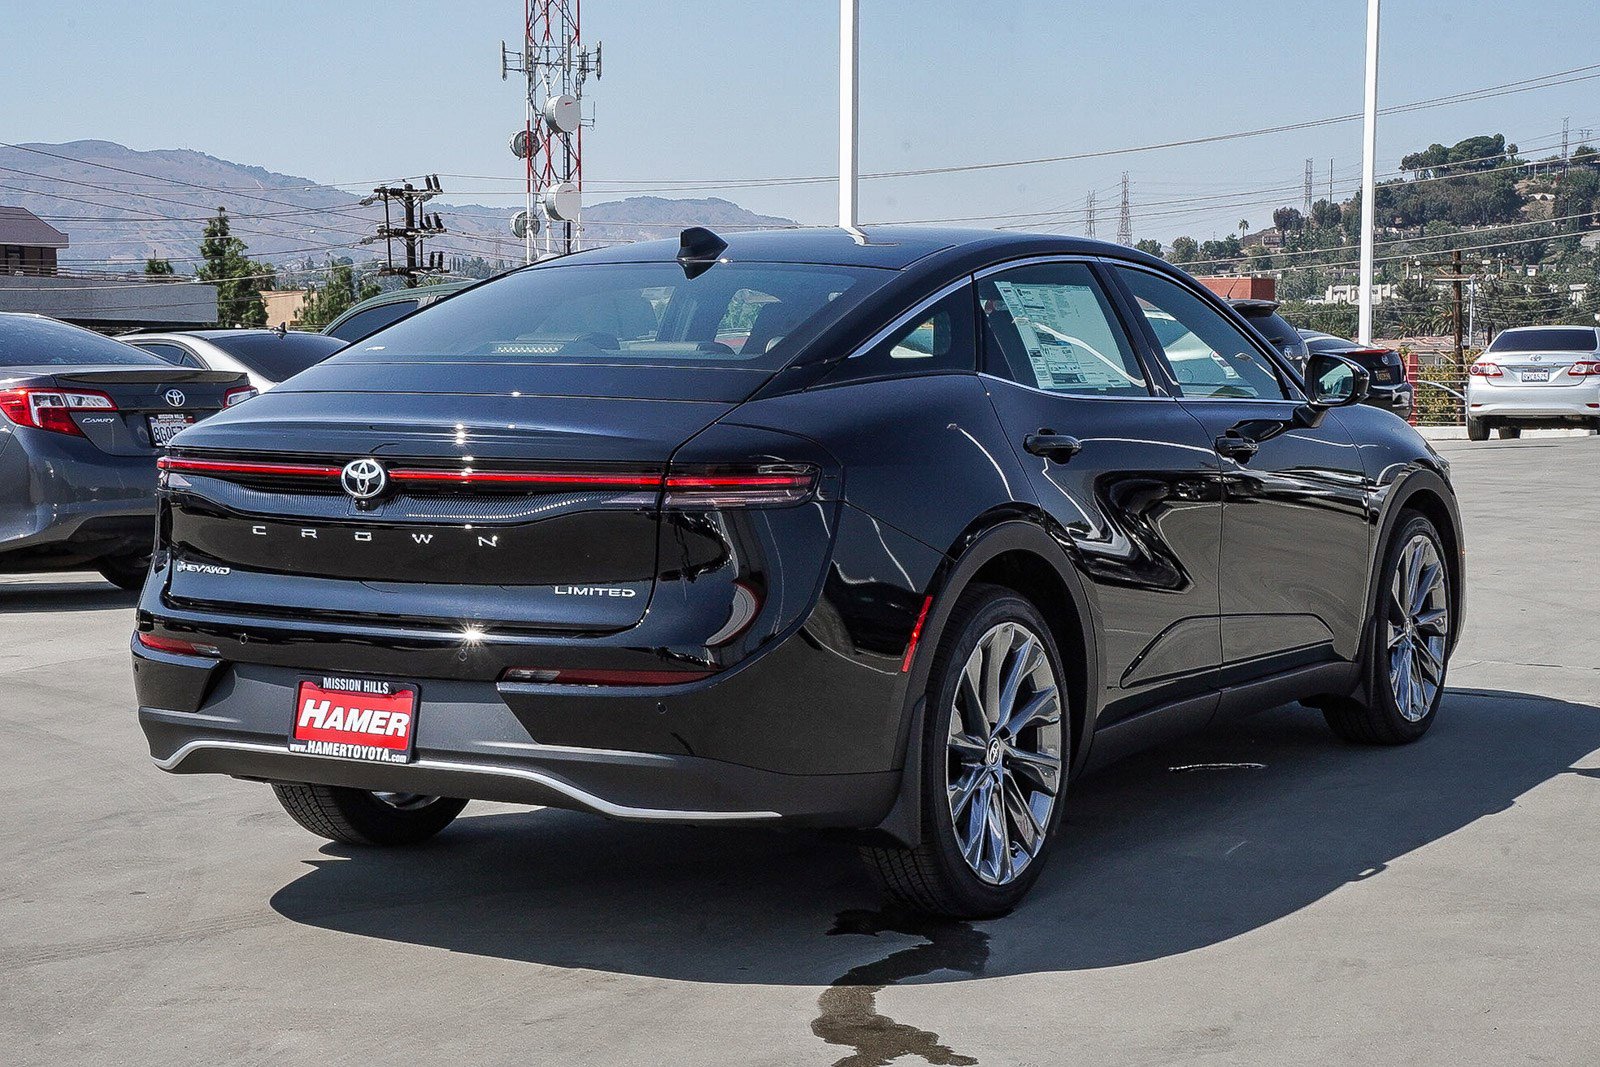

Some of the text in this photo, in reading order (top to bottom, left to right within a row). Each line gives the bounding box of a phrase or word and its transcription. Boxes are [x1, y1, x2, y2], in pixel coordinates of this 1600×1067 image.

[252, 525, 498, 547] CROWN
[554, 586, 636, 597] LIMITED
[323, 677, 389, 694] MISSION HILLS
[299, 699, 411, 737] HAMER
[289, 740, 407, 763] www.HAMERTOYOTA.com
